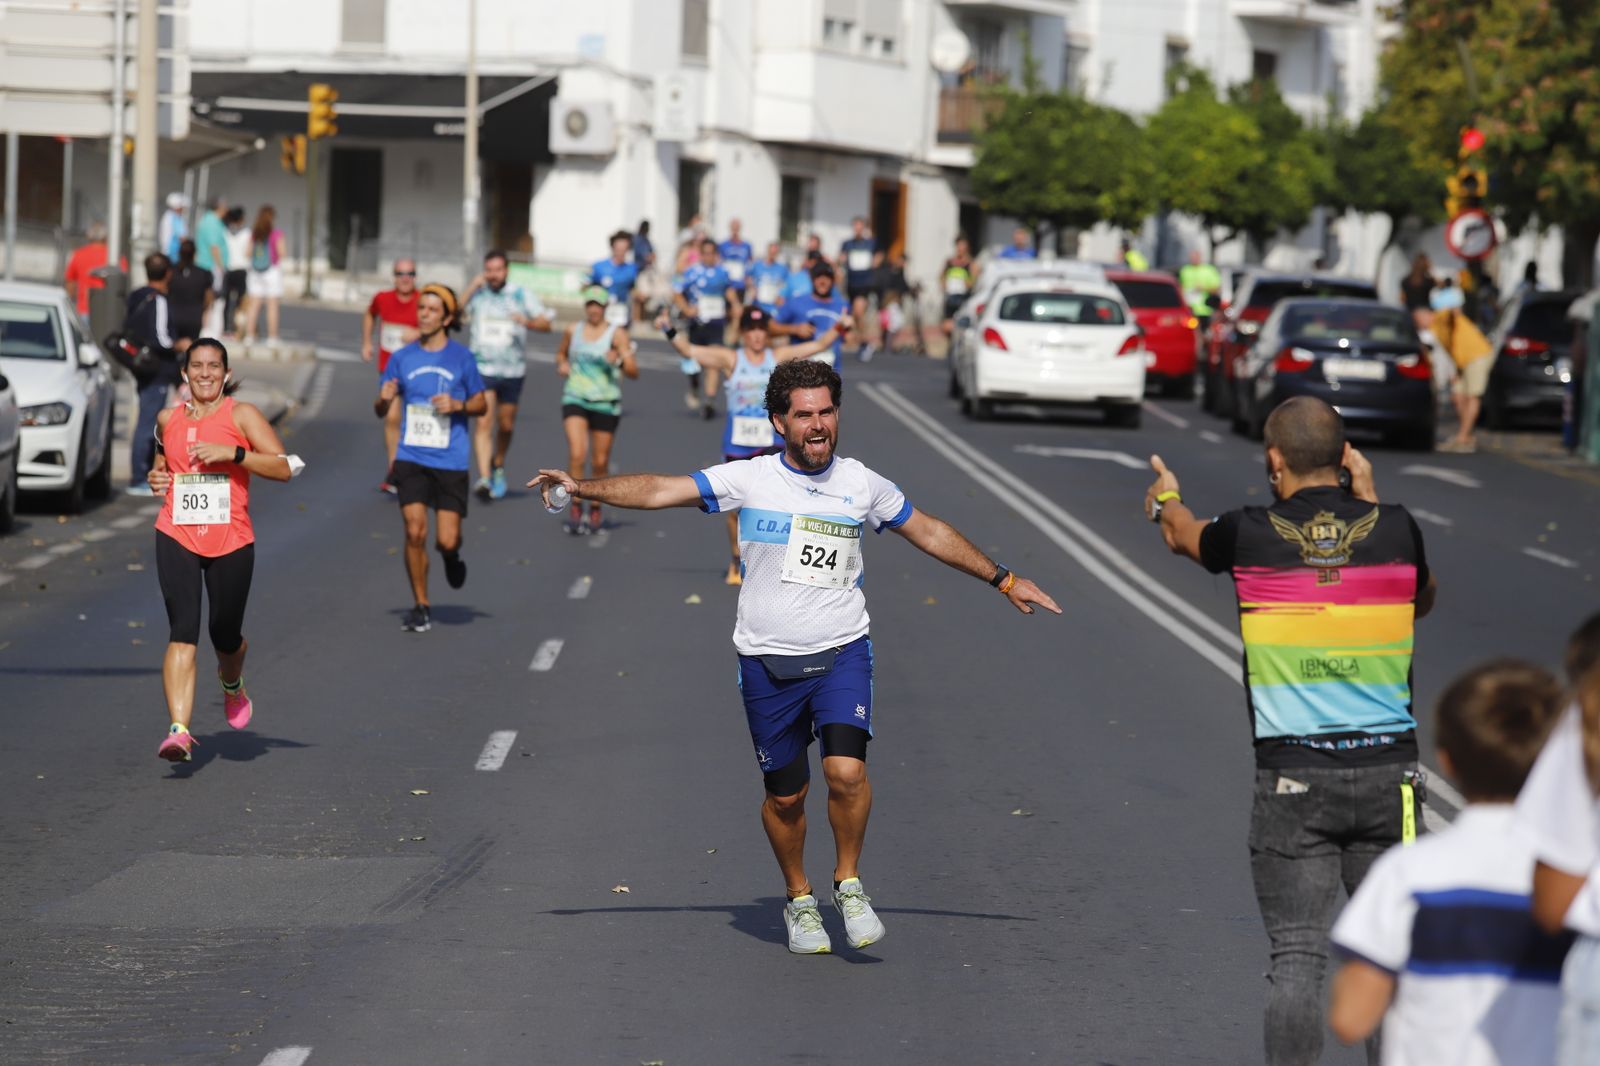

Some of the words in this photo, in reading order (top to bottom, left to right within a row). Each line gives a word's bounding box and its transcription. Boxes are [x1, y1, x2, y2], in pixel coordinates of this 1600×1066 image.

[182, 493, 209, 510] 503
[808, 520, 832, 534] VUELTA
[833, 526, 839, 536] A
[800, 544, 838, 570] 524
[1299, 657, 1361, 672] IBHOLA
